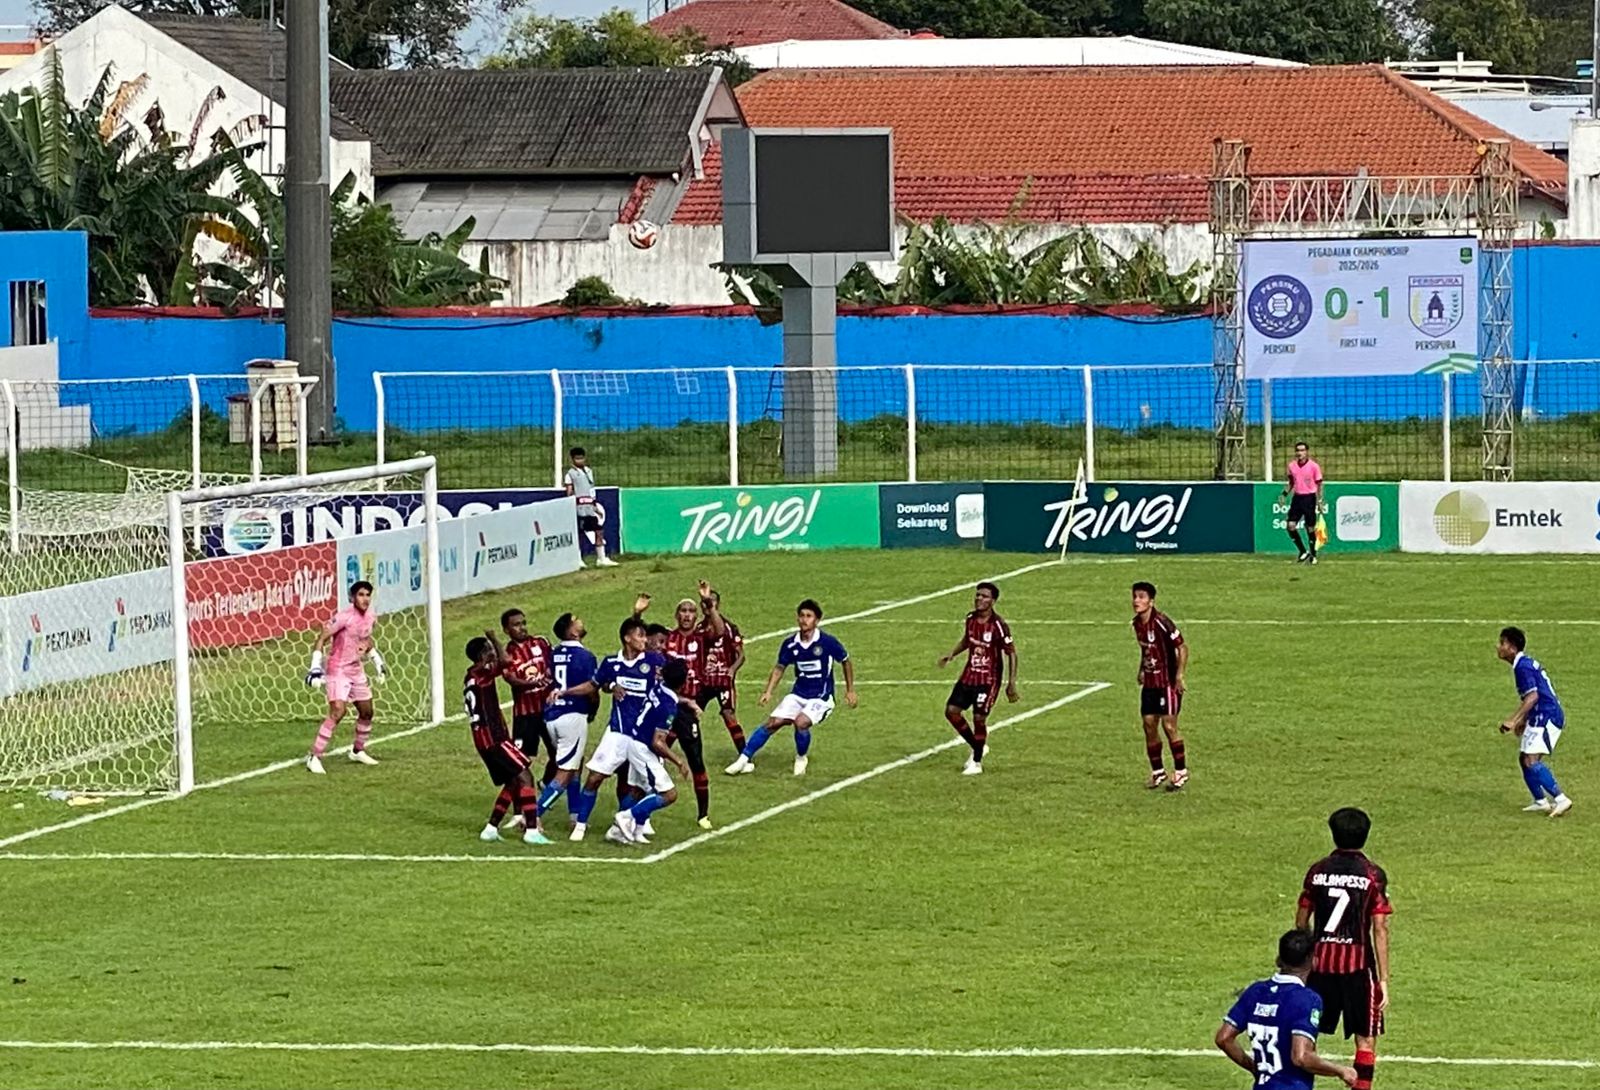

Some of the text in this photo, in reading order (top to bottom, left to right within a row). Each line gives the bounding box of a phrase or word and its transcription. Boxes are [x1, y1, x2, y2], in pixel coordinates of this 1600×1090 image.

[1308, 246, 1409, 257] PEGADAIAN CHAMPIONSHIP
[1339, 260, 1379, 271] 2025/2026
[1260, 280, 1300, 294] PERSIKU
[1325, 287, 1348, 320] 0
[1374, 286, 1389, 318] 1
[1340, 337, 1377, 348] FIRST HALF
[1415, 340, 1456, 350] PERSIPURA
[896, 502, 950, 513] Download
[897, 518, 948, 531] Sekarang
[1495, 508, 1562, 528] Emtek
[378, 558, 400, 586] PLN
[1312, 873, 1371, 890] SALAMPESSY
[1323, 887, 1350, 933] 7
[1247, 1022, 1283, 1075] 33
